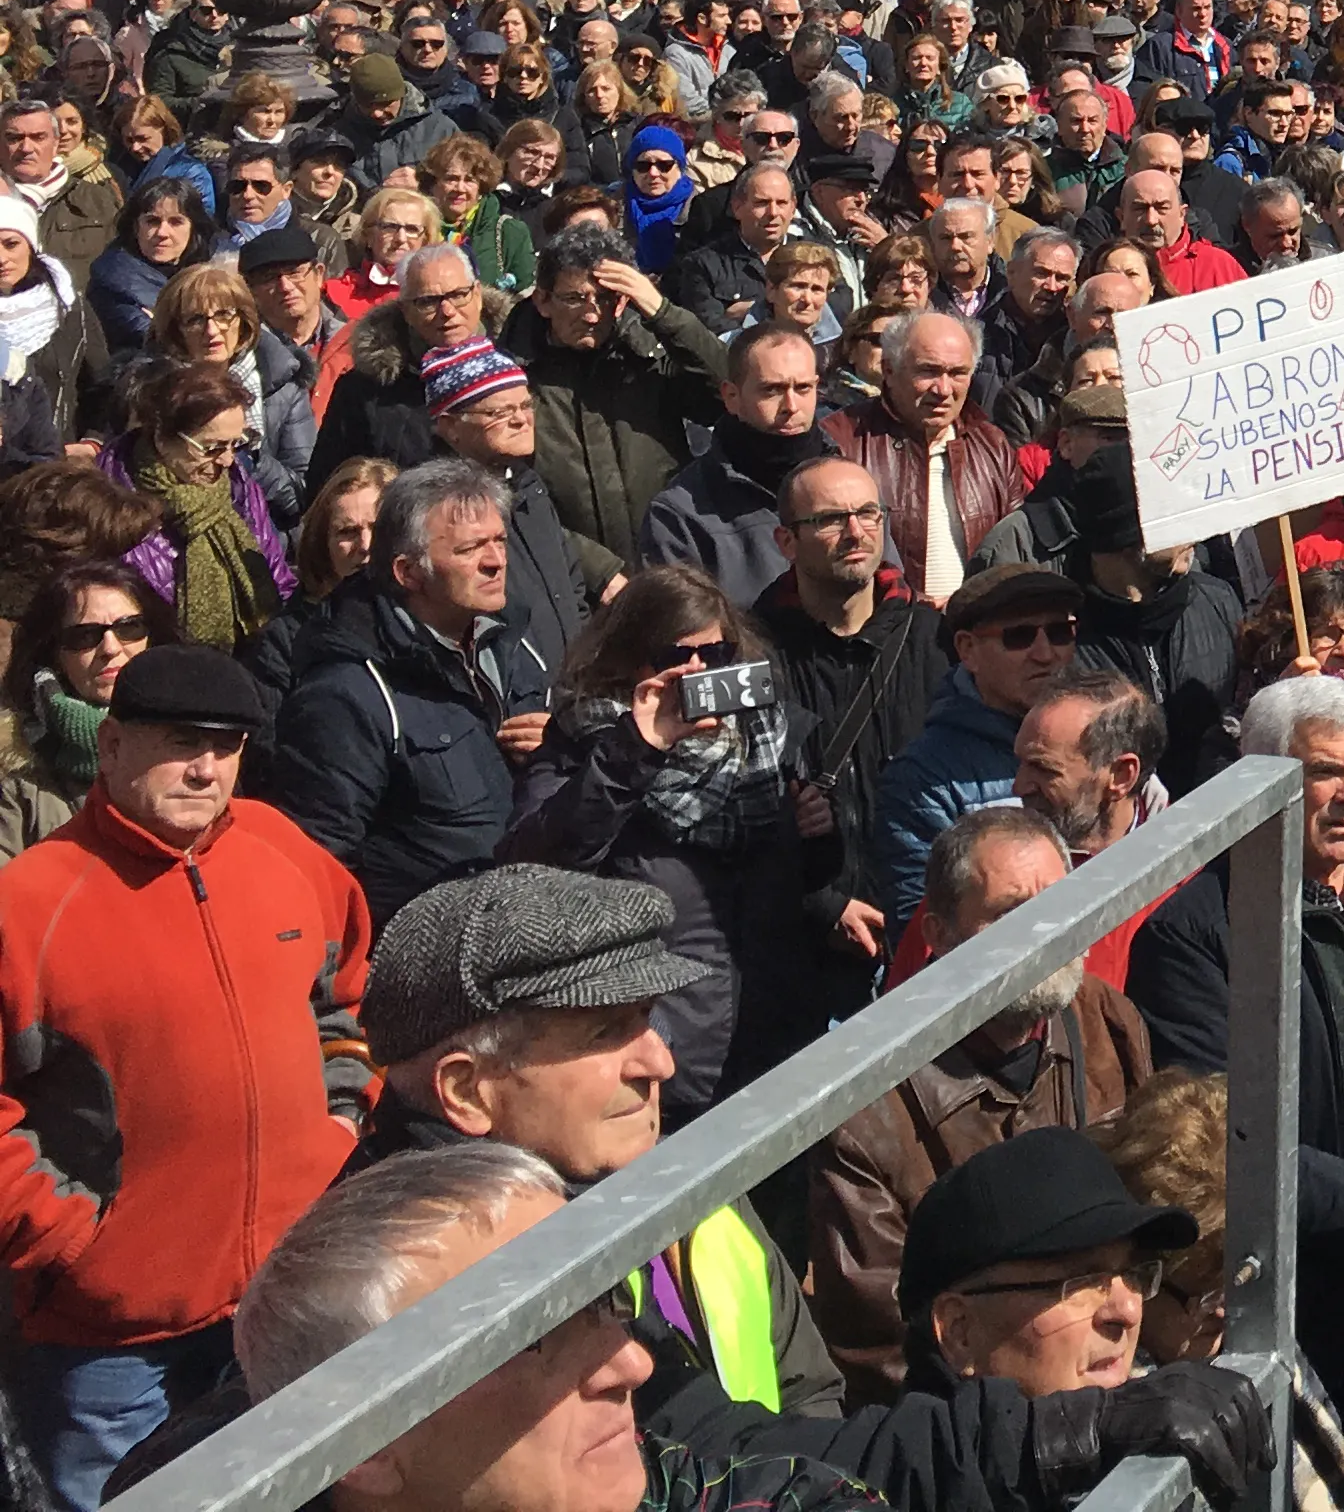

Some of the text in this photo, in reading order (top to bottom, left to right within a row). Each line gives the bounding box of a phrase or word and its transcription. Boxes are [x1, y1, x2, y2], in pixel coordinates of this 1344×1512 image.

[1197, 393, 1339, 460] SUBENOS
[1162, 437, 1191, 471] RAJOY
[1204, 468, 1236, 500] LA
